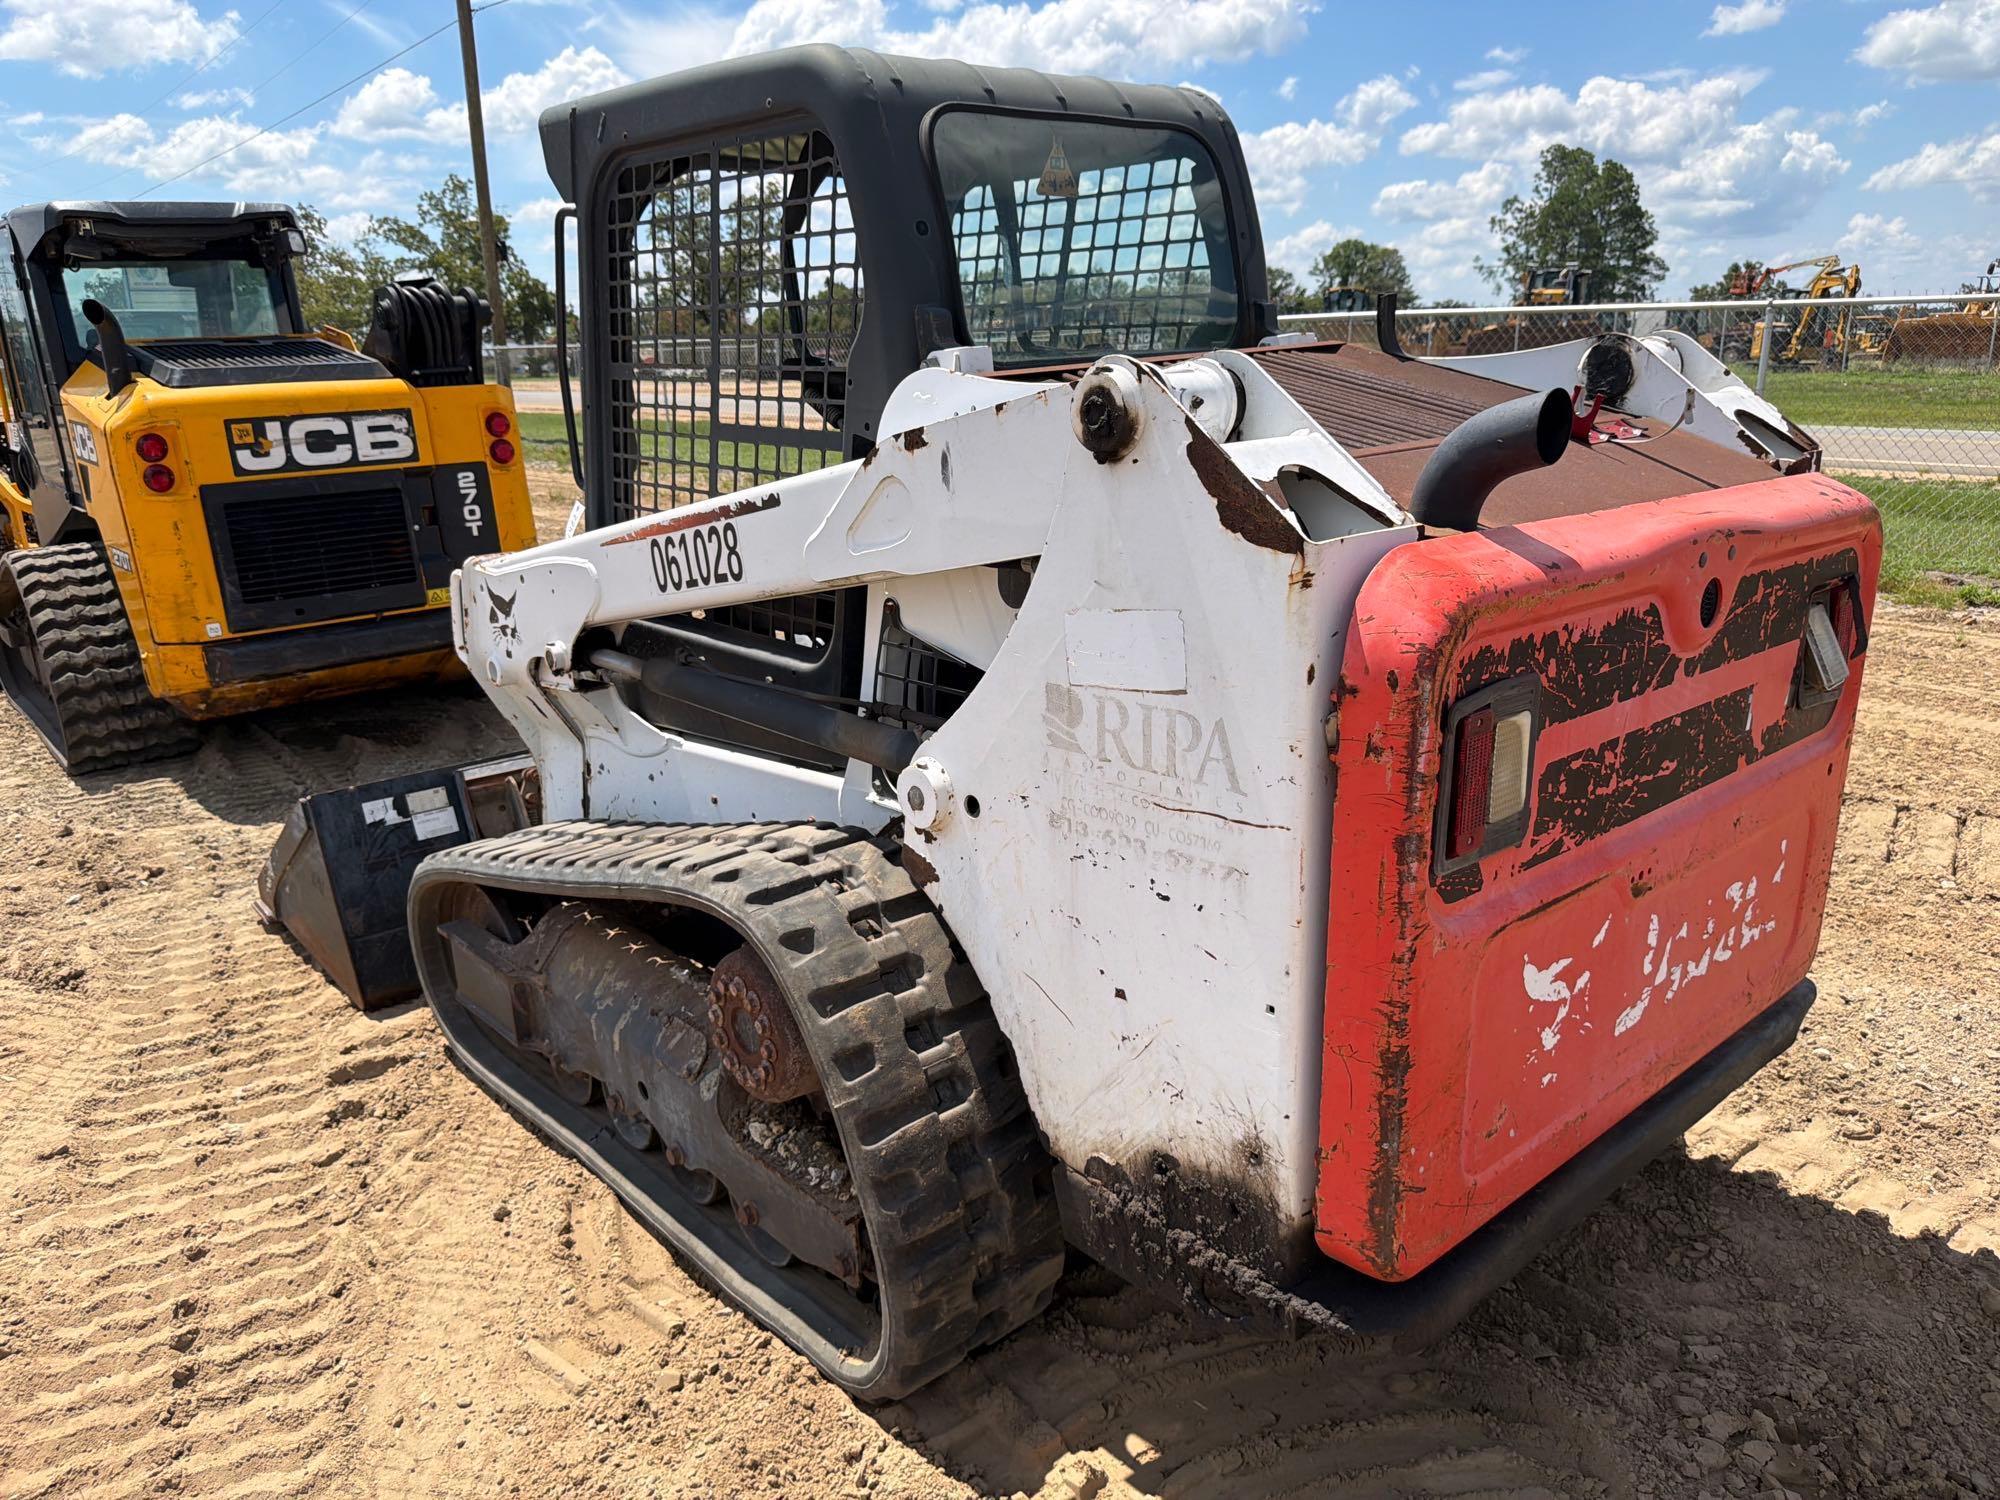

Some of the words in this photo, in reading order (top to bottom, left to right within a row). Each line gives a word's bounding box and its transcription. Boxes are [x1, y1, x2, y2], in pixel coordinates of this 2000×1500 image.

[236, 414, 414, 471] JCB
[457, 471, 483, 537] 270T
[651, 522, 743, 593] 061028
[1092, 694, 1248, 798] RIPA
